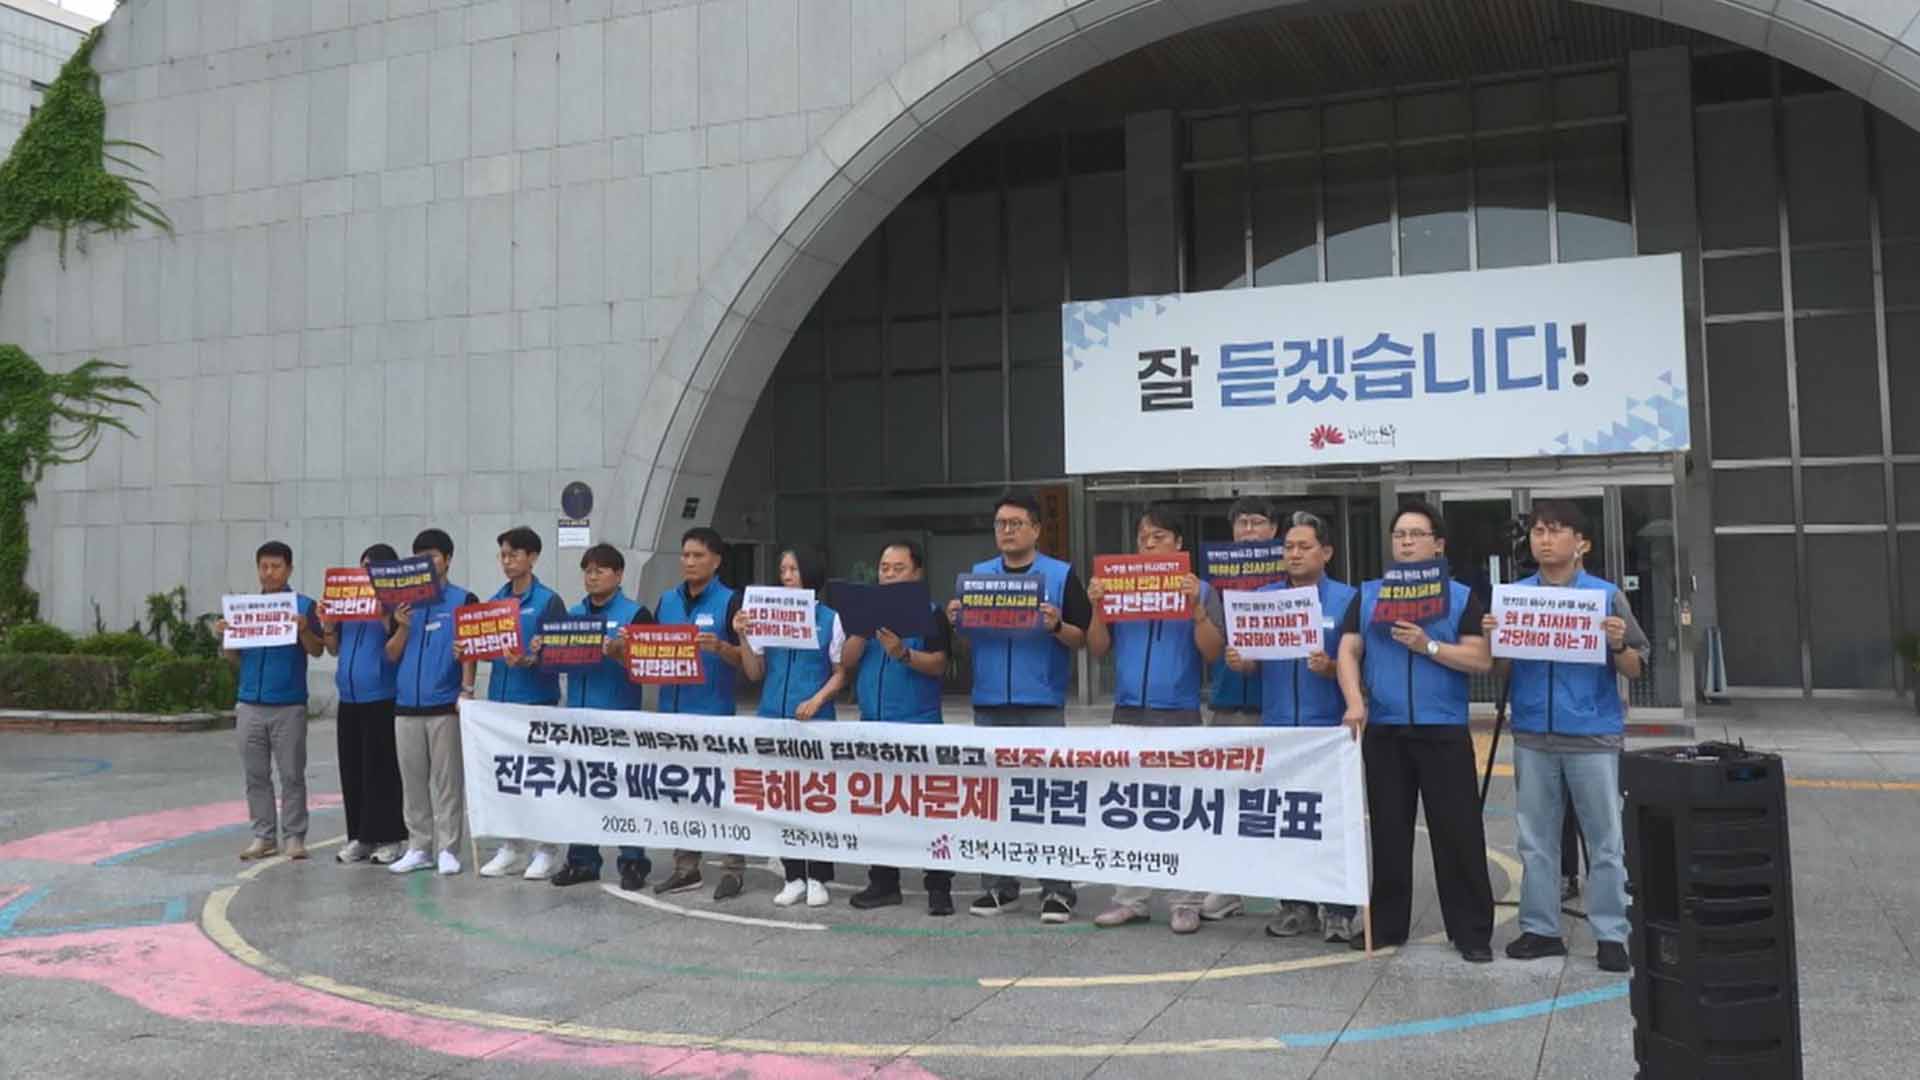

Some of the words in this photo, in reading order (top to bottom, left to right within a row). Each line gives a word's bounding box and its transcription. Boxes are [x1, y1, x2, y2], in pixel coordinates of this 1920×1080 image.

[1138, 345, 1200, 412] 잘
[1216, 321, 1590, 408] 듣겠습니다!
[636, 729, 700, 754] 배우자
[703, 735, 748, 755] 인사
[755, 738, 824, 761] 문제에
[936, 746, 987, 766] 말고
[493, 754, 617, 799] 전주시장
[626, 761, 724, 808] 배우자
[733, 767, 837, 813] 특혜성
[847, 772, 999, 821] 인사문제
[1009, 777, 1087, 826] 관련
[1099, 782, 1225, 835] 성명서
[1237, 788, 1323, 840] 발표
[712, 824, 751, 841] 11:00
